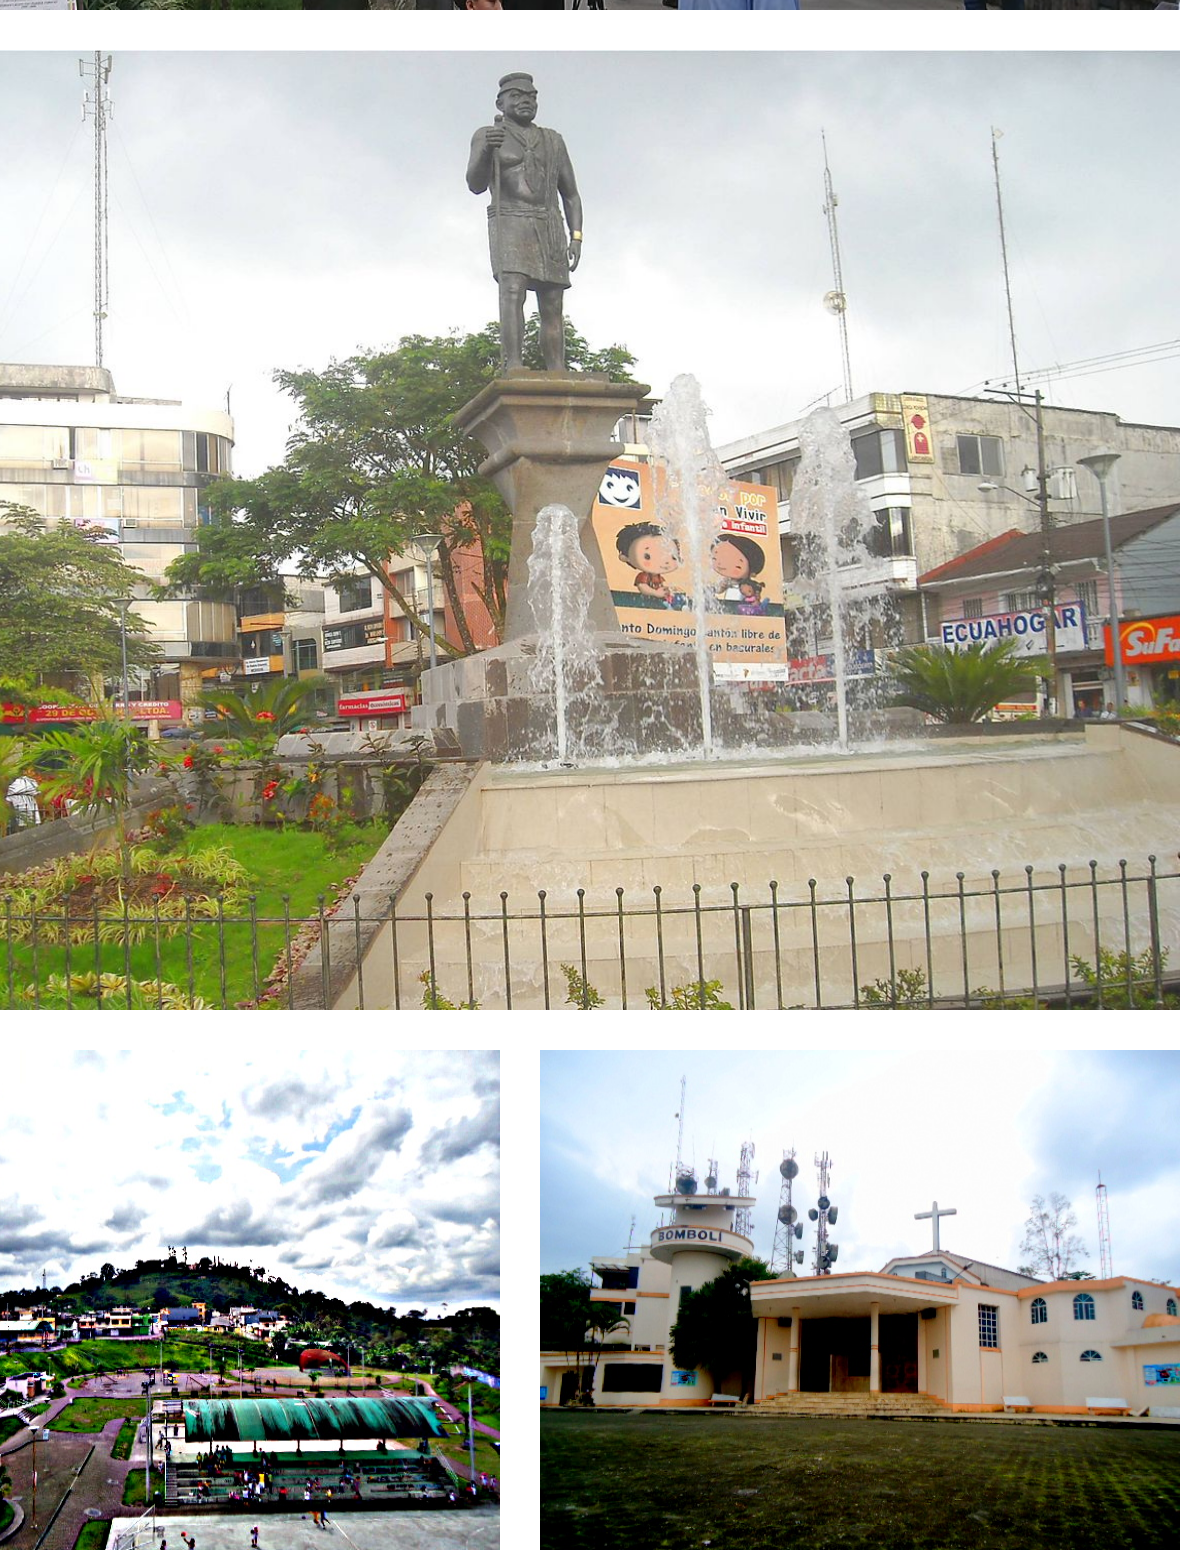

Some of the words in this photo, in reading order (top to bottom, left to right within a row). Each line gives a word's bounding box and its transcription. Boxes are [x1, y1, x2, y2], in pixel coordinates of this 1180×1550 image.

[740, 491, 766, 507] por
[735, 506, 766, 521] Vivir
[620, 624, 642, 635] nto
[646, 623, 697, 638] Domingo
[704, 628, 738, 638] antón
[741, 628, 765, 640] libre
[768, 630, 781, 640] de
